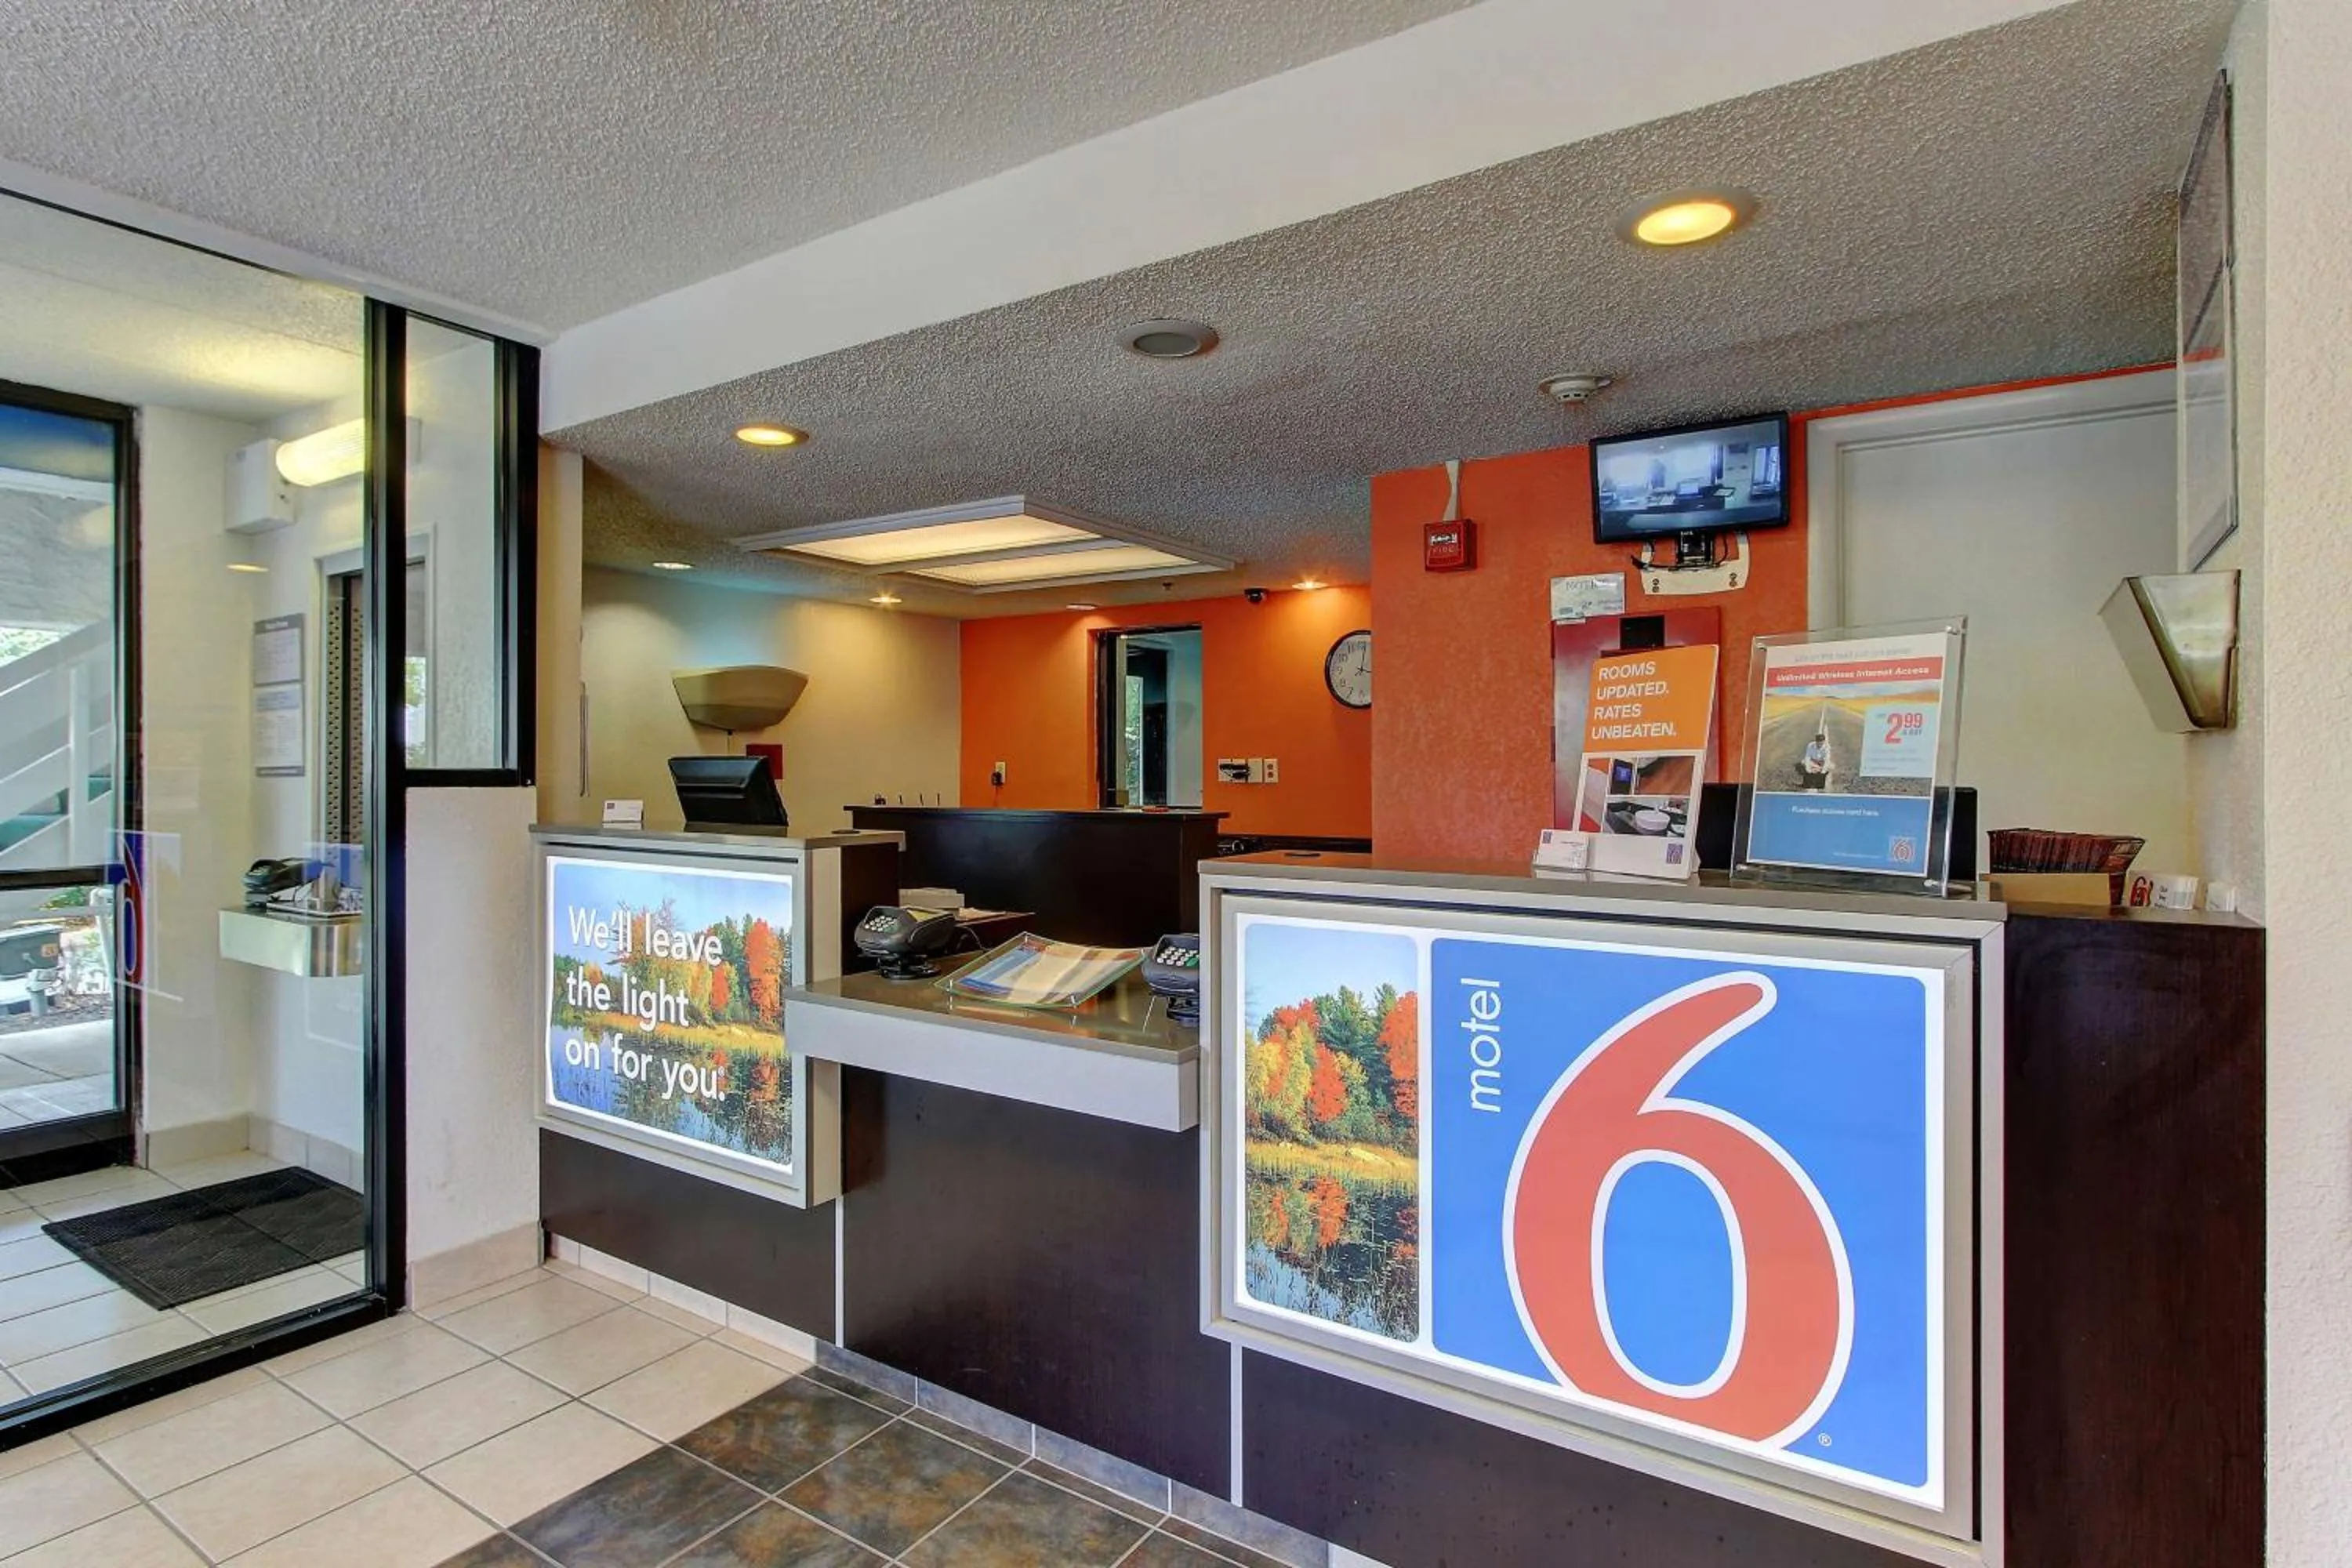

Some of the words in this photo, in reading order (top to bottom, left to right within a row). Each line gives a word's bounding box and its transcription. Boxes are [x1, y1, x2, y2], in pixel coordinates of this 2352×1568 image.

[1599, 661, 1656, 681] ROOMS
[1895, 665, 1929, 675] Access
[1595, 681, 1669, 700] UPDATED.
[1593, 703, 1642, 720] RATES
[1592, 721, 1677, 740] UNBEATEN.
[568, 906, 632, 953] We'll
[645, 913, 722, 966] leave
[566, 966, 611, 1011] the
[622, 972, 689, 1032] light
[565, 1037, 600, 1070] on
[612, 1033, 652, 1081] for
[1461, 977, 1501, 1112] motel
[1502, 970, 1855, 1452] 6
